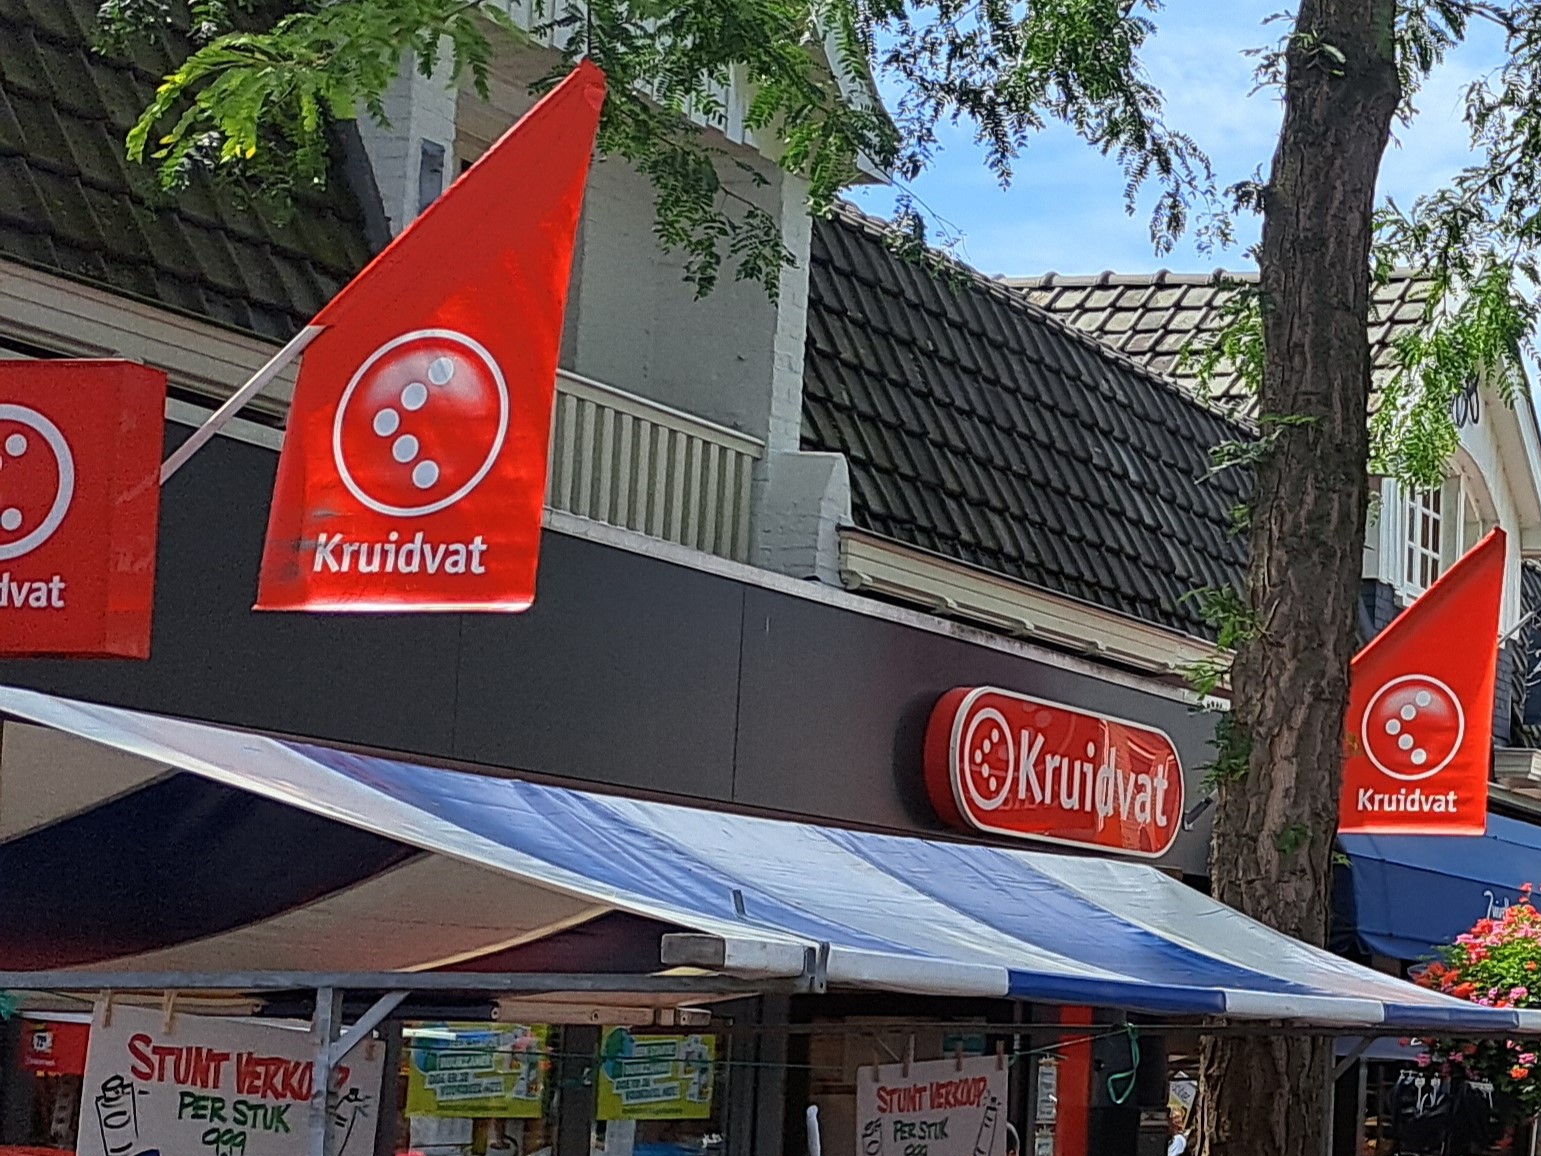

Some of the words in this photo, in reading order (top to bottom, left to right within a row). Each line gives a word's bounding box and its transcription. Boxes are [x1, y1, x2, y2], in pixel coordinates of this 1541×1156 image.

[313, 532, 488, 577] Kruidvat
[1018, 730, 1168, 827] Kruidvat
[1357, 787, 1457, 814] Kruidvat
[128, 1034, 230, 1090] STUNT
[236, 1052, 350, 1102] VERKO
[178, 1092, 228, 1123] PER
[232, 1099, 292, 1133] STUK
[877, 1085, 927, 1114] STUNT
[893, 1119, 916, 1142] PER
